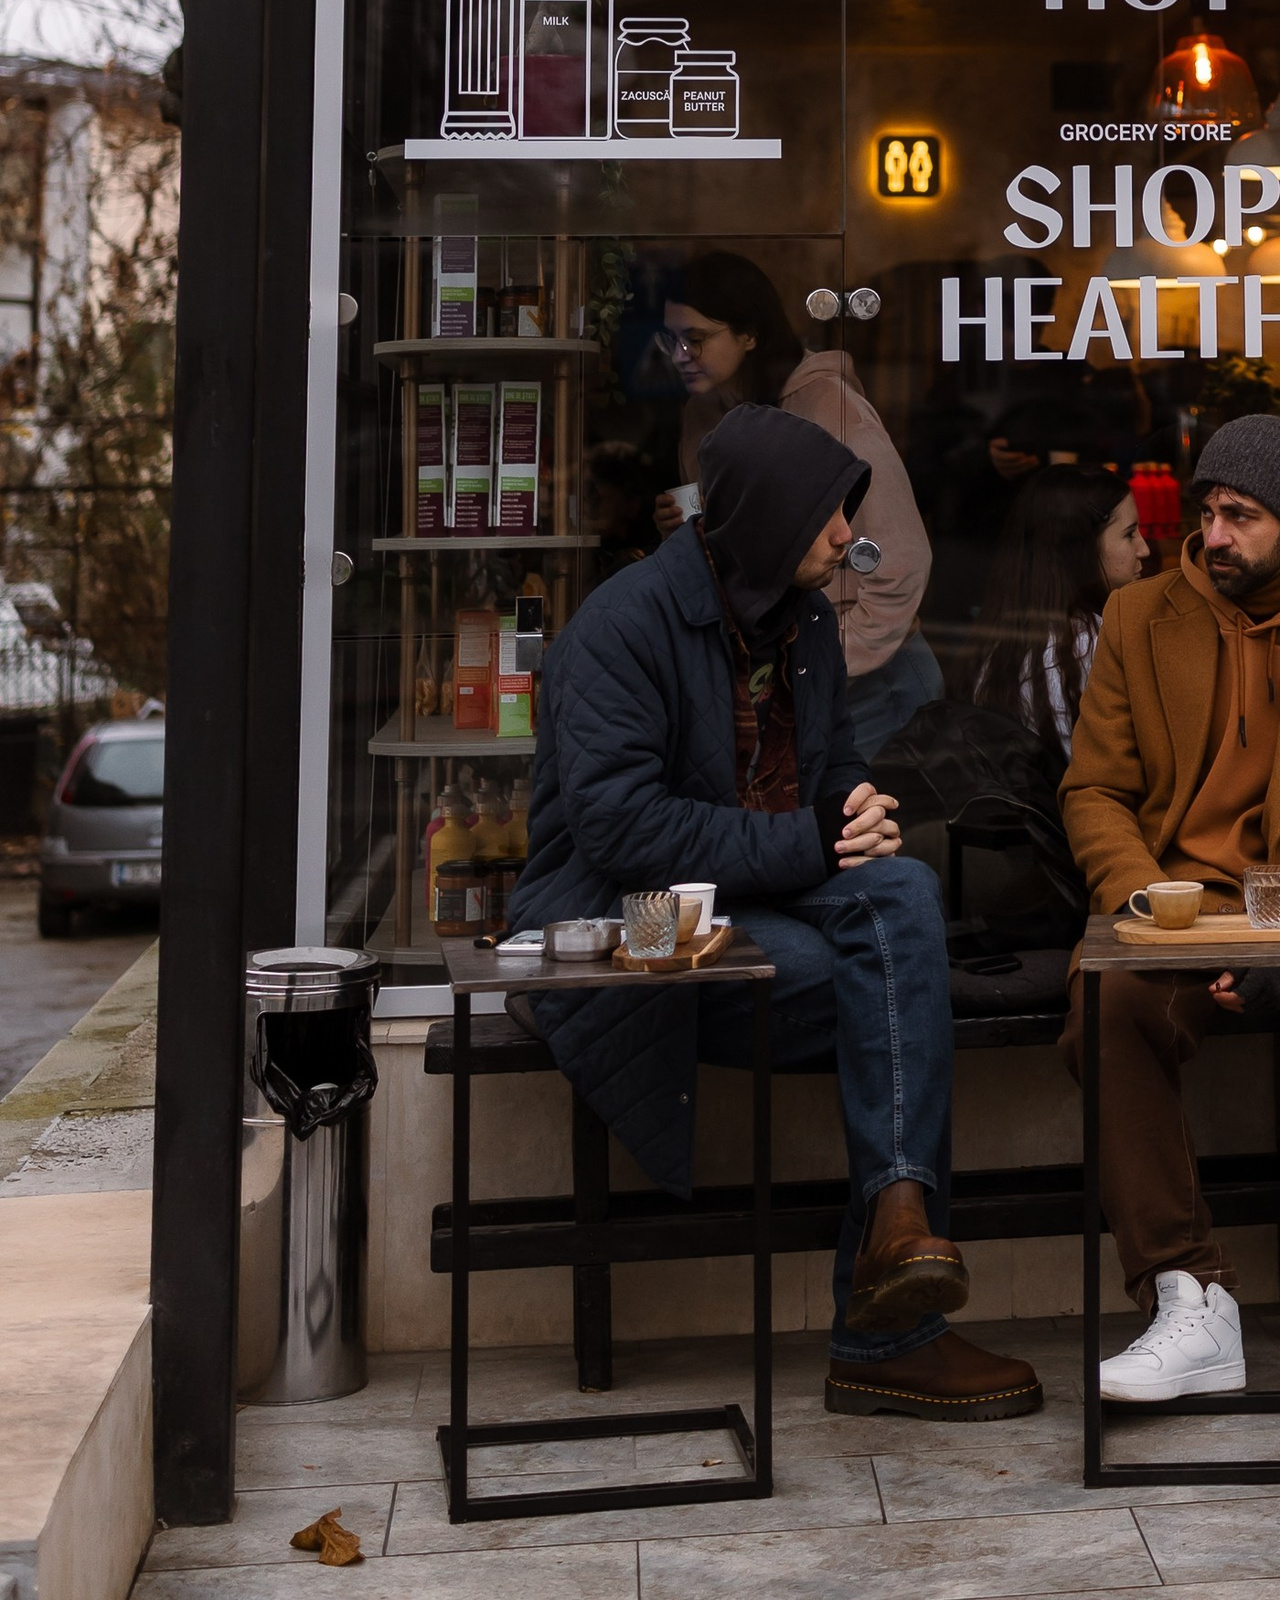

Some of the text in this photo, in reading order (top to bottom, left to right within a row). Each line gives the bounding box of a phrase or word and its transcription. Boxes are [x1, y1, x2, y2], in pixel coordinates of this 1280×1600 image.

[542, 17, 570, 26] MILK
[683, 91, 726, 101] PEANUT
[684, 102, 725, 112] BUTTER
[1060, 123, 1232, 141] GROCERY STORE
